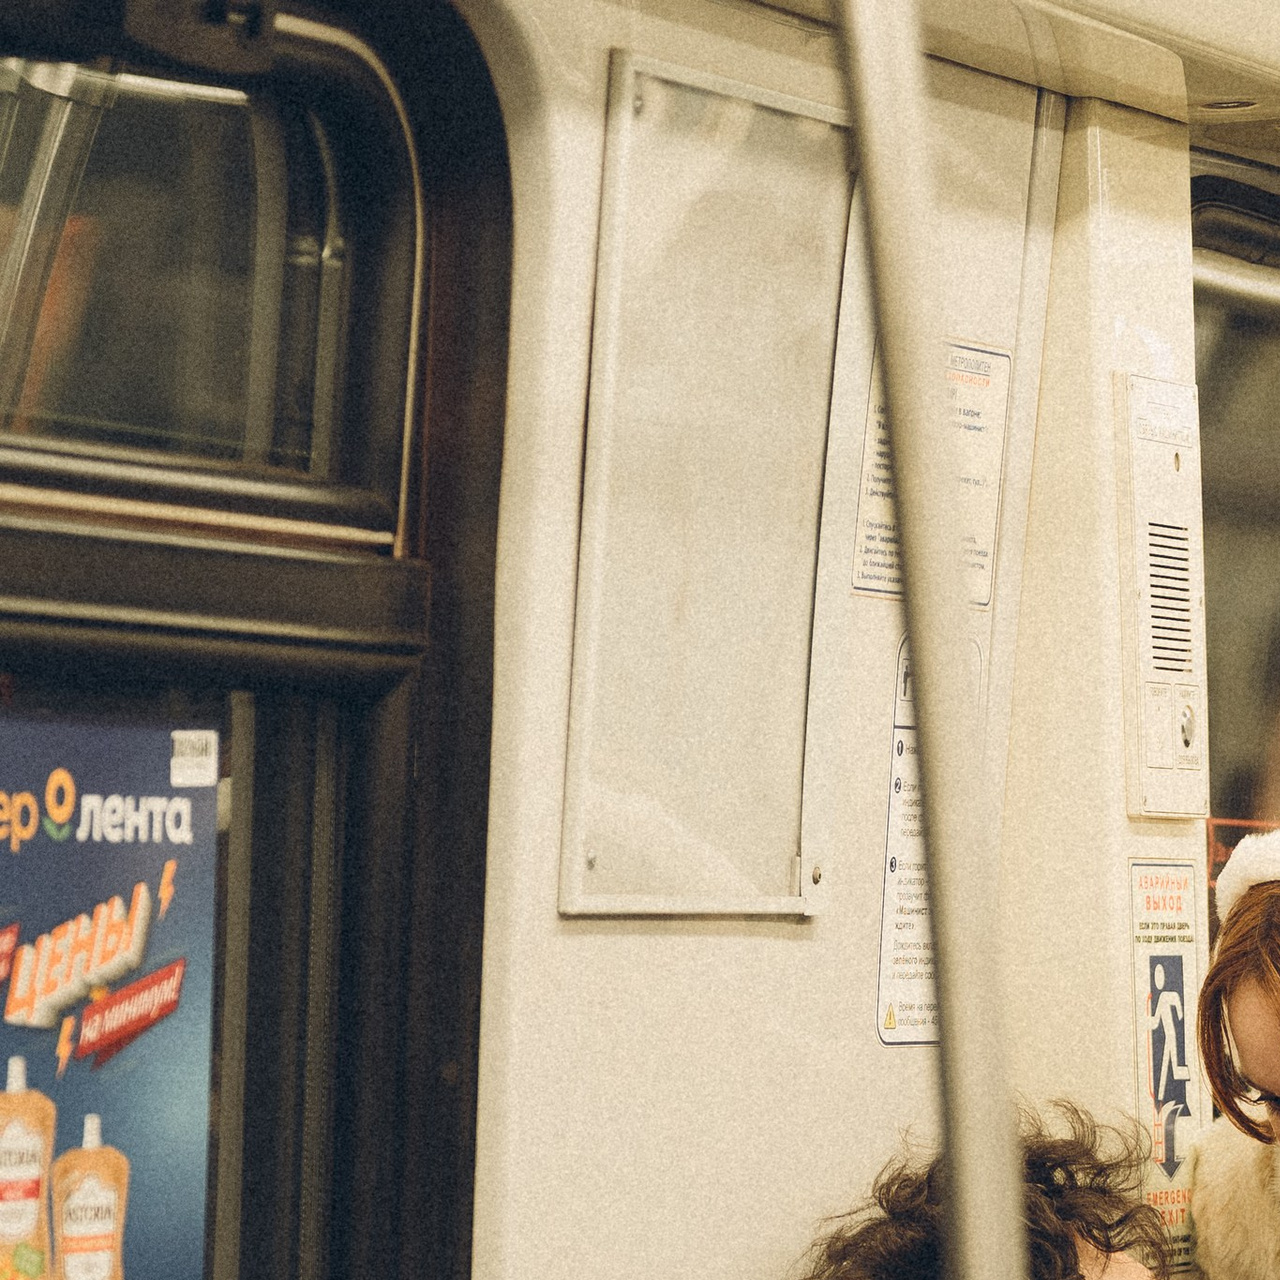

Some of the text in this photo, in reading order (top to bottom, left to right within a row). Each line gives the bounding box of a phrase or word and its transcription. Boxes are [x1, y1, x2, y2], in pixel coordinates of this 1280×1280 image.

[75, 793, 194, 844] лента
[1138, 873, 1188, 891] АВАРИЙНЫЙ
[1145, 895, 1183, 913] ВЫХОД
[5, 881, 151, 1028] ЦЕНЫ
[1146, 1188, 1192, 1206] EMERGENC
[1160, 1208, 1186, 1227] EXIT
